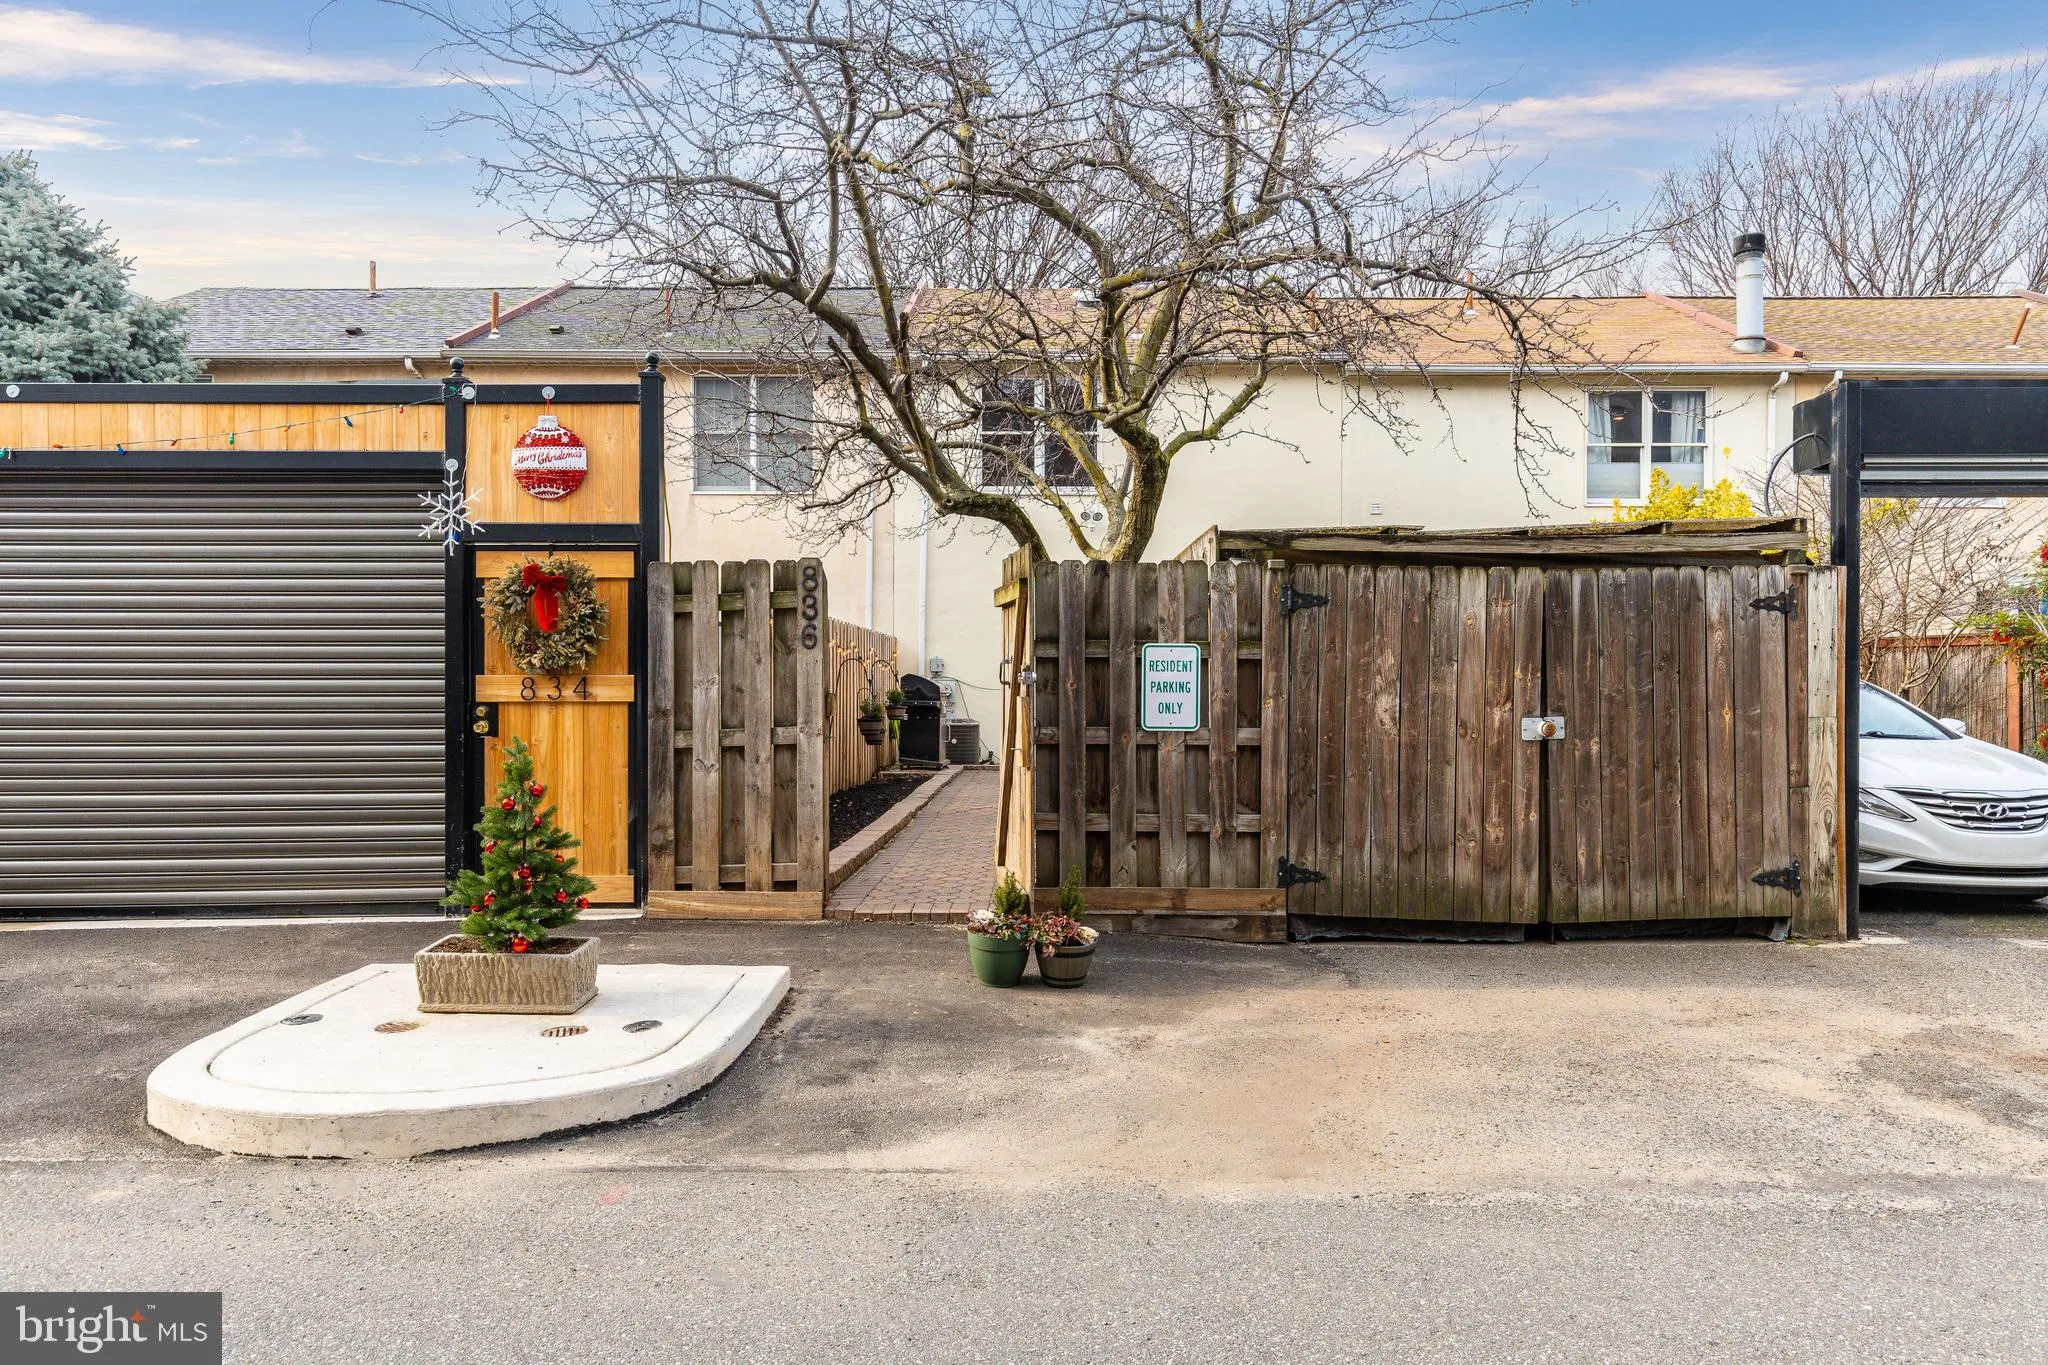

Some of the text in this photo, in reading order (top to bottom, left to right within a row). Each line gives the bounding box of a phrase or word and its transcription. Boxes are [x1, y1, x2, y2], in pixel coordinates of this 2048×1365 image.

[538, 450, 582, 464] Christmas
[801, 566, 818, 650] 836
[1149, 660, 1193, 672] RESIDENT
[520, 676, 589, 701] 834
[1150, 681, 1191, 693] PARKING
[1158, 702, 1183, 714] ONLY
